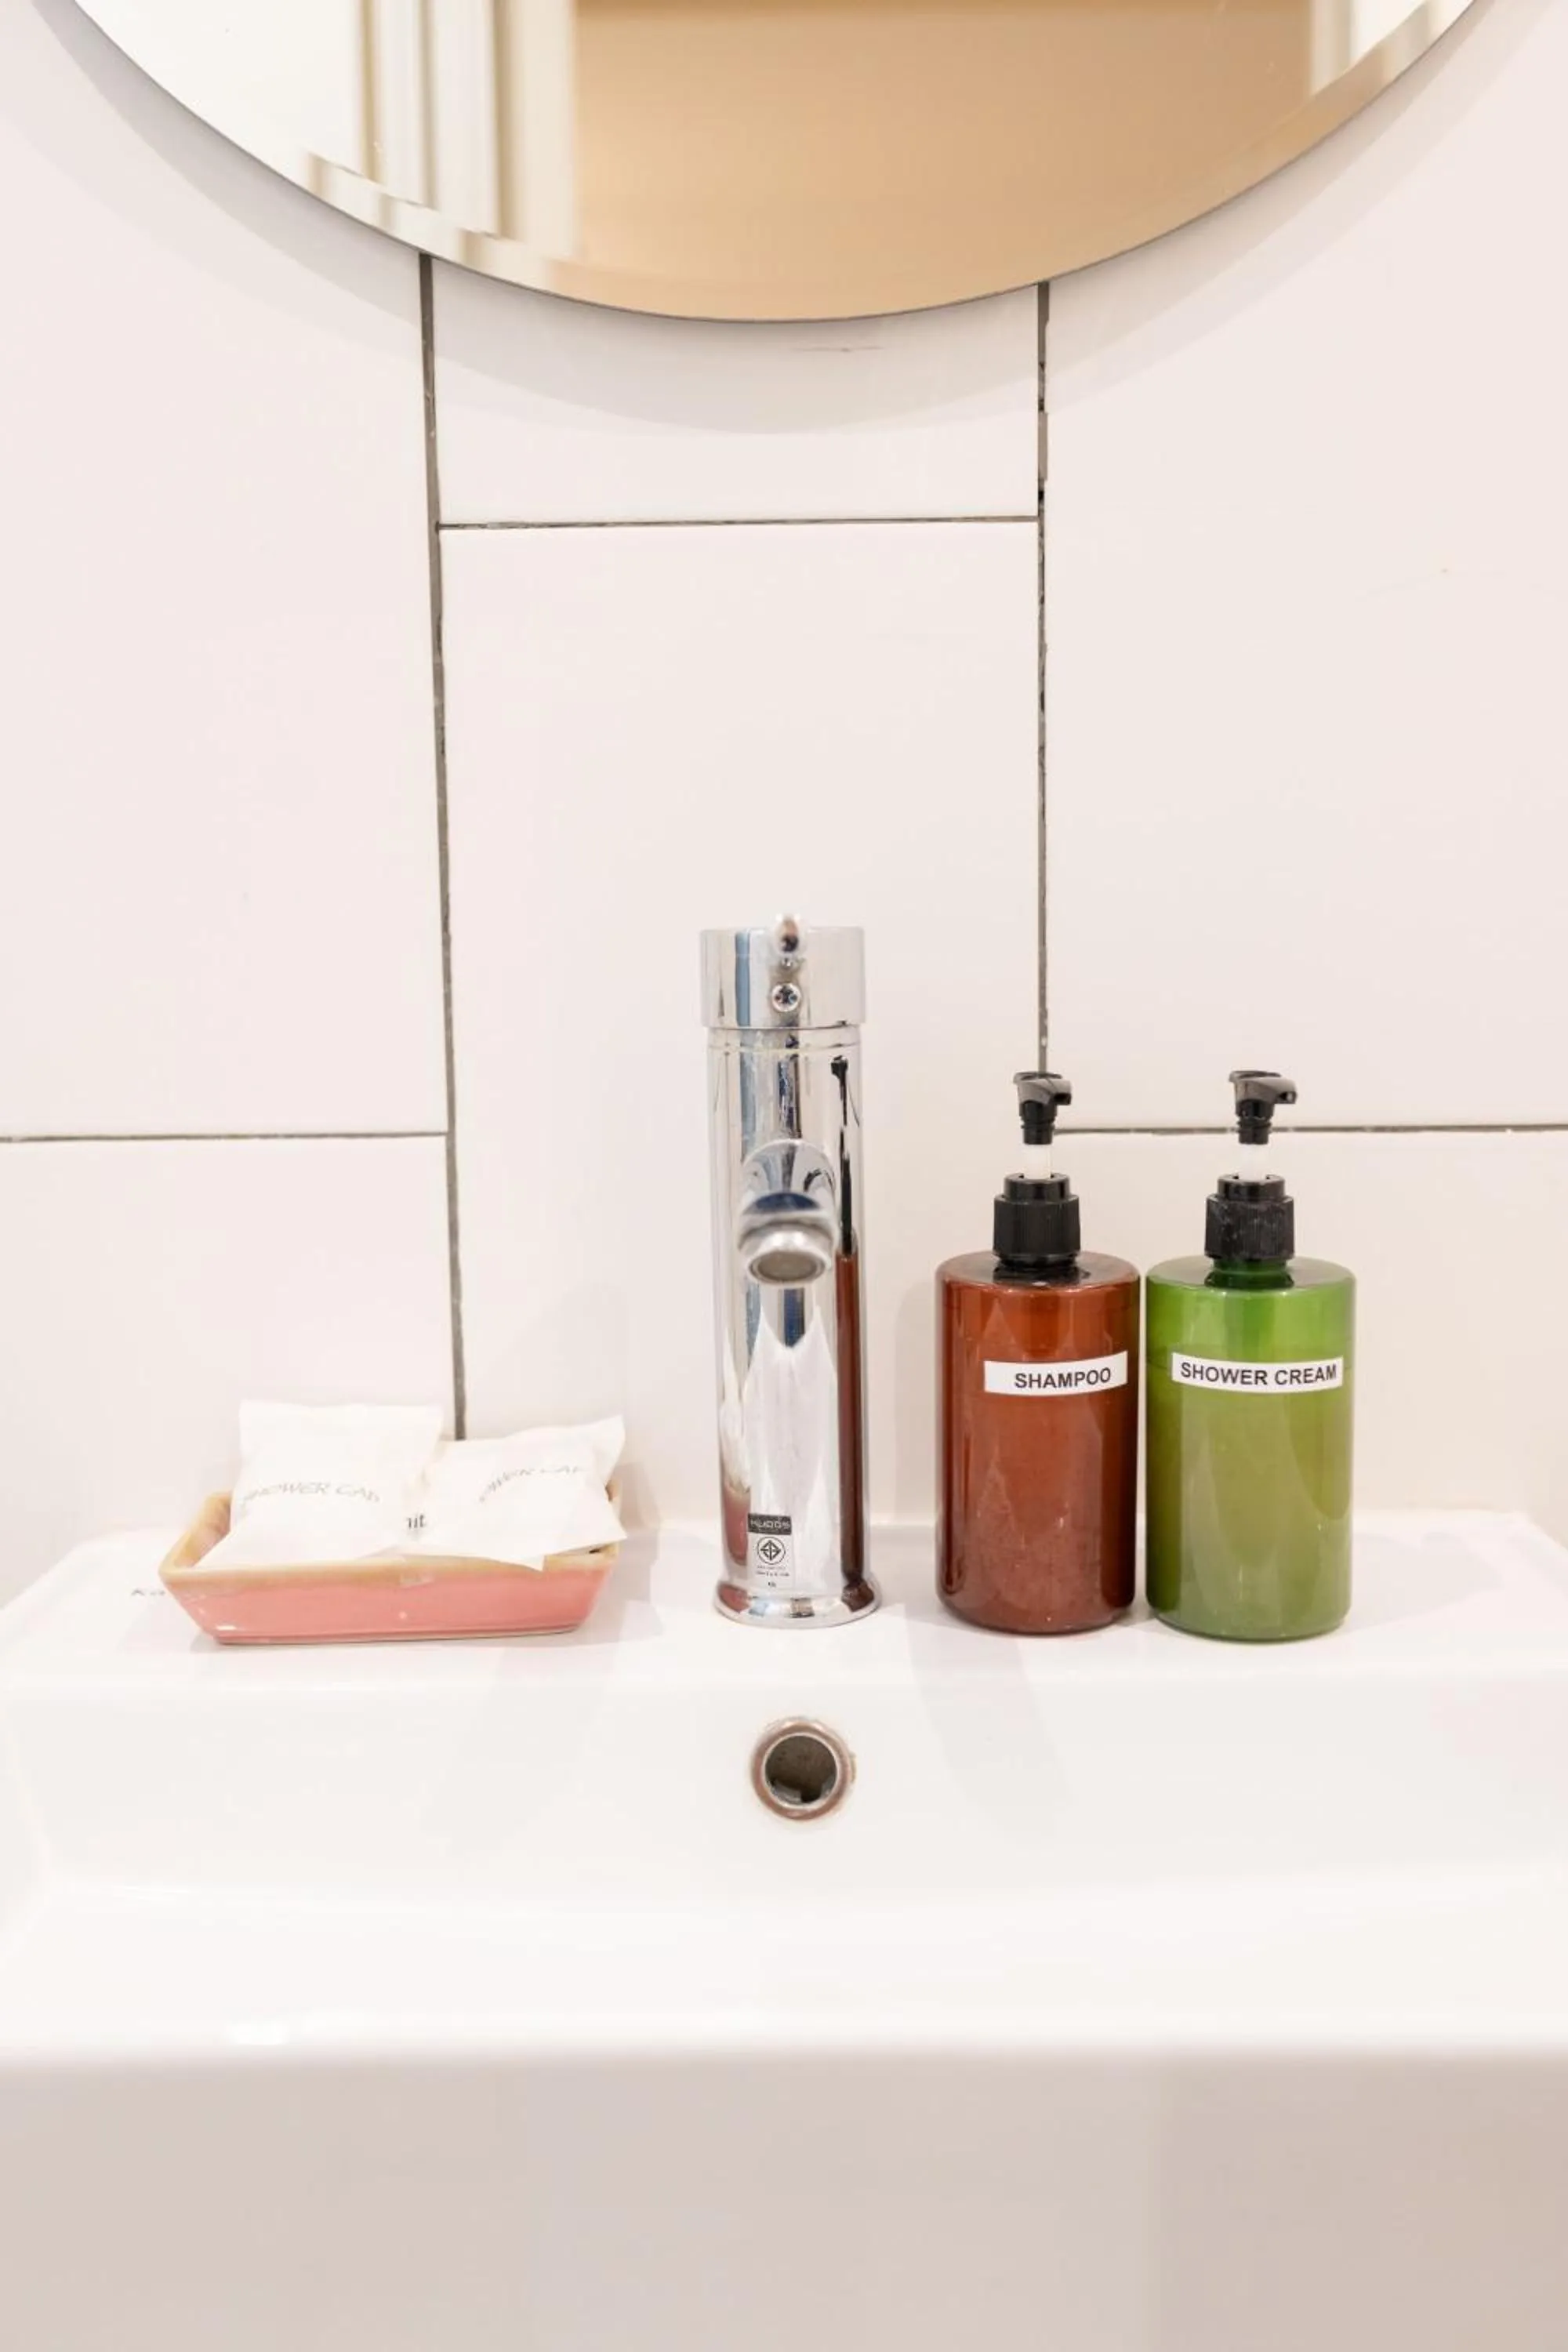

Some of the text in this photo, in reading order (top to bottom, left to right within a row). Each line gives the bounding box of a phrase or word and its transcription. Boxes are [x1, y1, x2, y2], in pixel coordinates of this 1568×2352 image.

[1014, 1367, 1112, 1389] SHAMPOO
[1181, 1362, 1337, 1386] SHOWER CREAM
